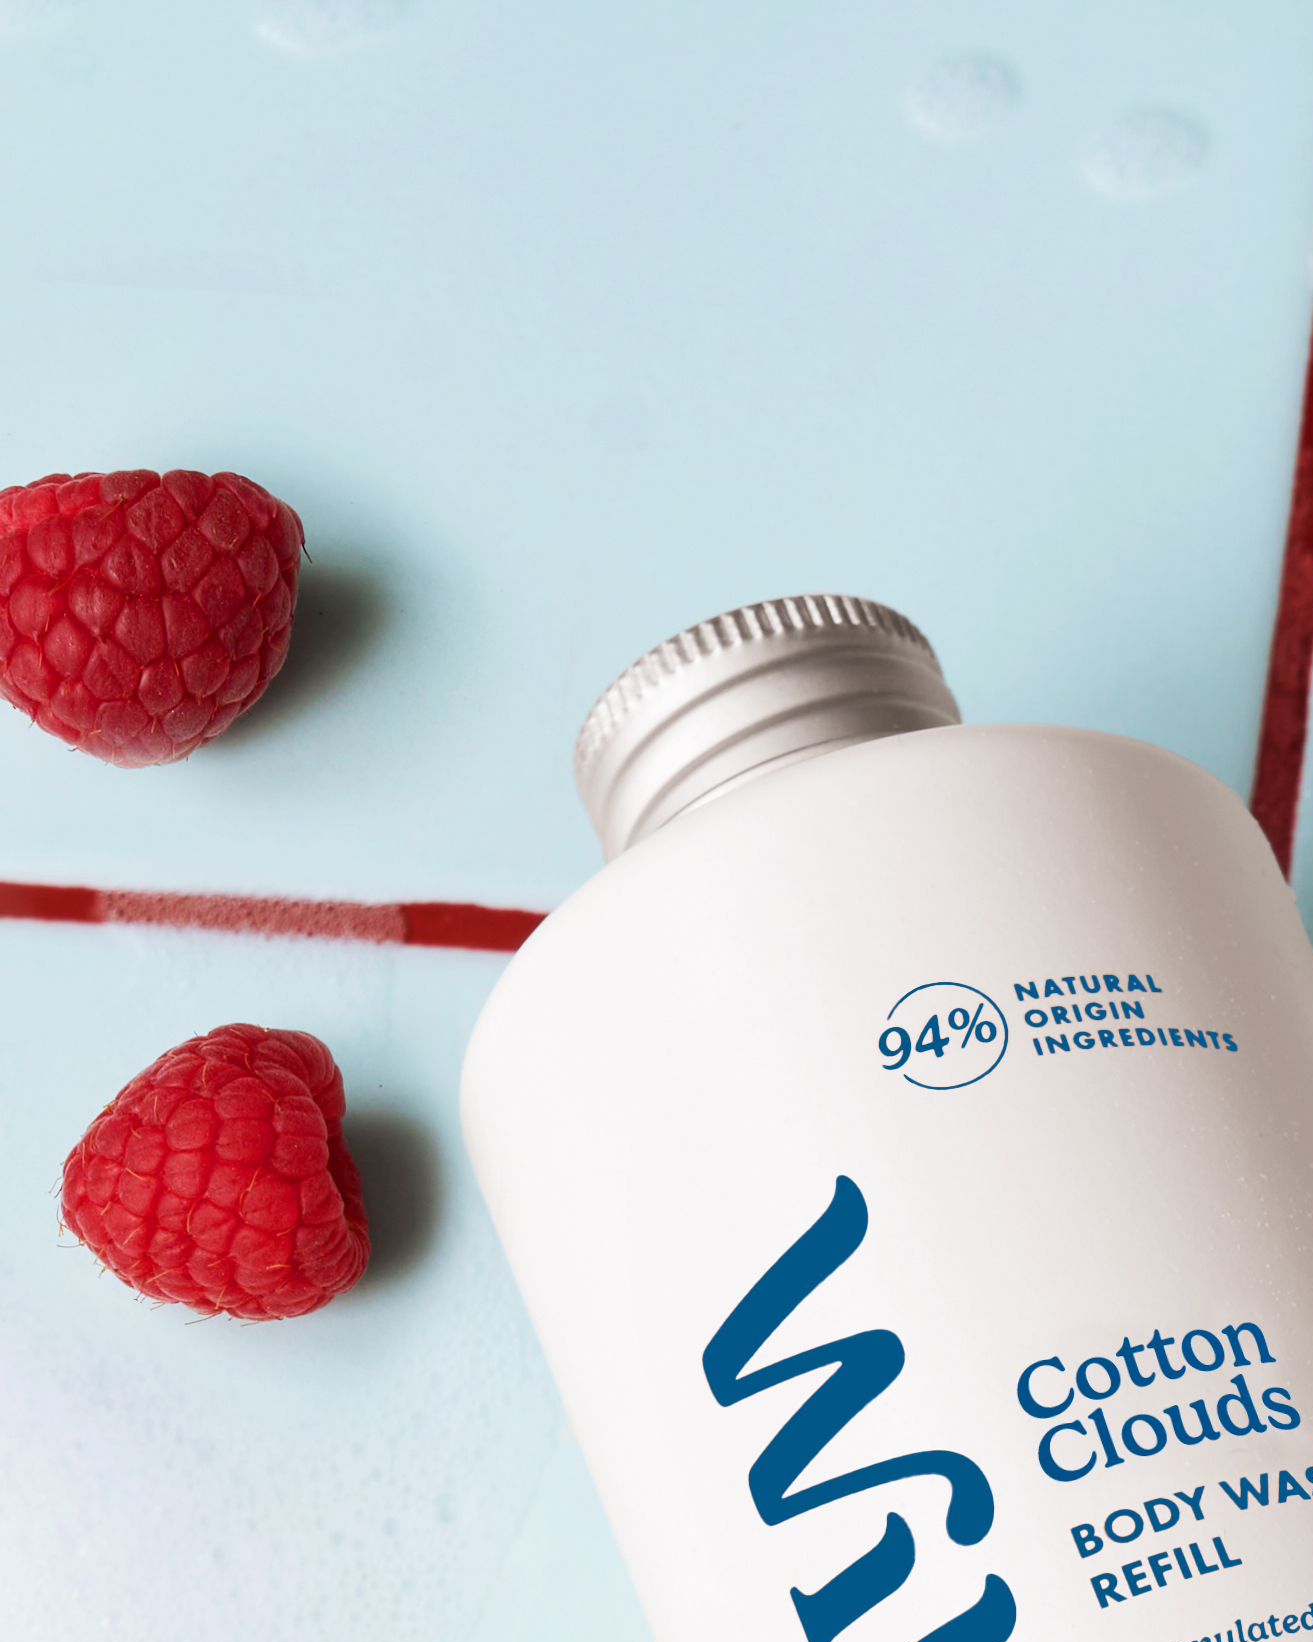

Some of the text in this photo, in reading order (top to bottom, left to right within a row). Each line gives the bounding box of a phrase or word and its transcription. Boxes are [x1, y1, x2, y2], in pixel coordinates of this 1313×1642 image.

[1014, 974, 1162, 1001] NATURAL
[1024, 1001, 1145, 1027] ORIGIN
[879, 1003, 997, 1070] 94%
[1032, 1028, 1238, 1056] INGREDIENTS
[1017, 1322, 1276, 1418] Cotton
[1038, 1374, 1300, 1482] Clouds
[1071, 1485, 1205, 1558] BODY
[1090, 1537, 1242, 1608] REFILL
